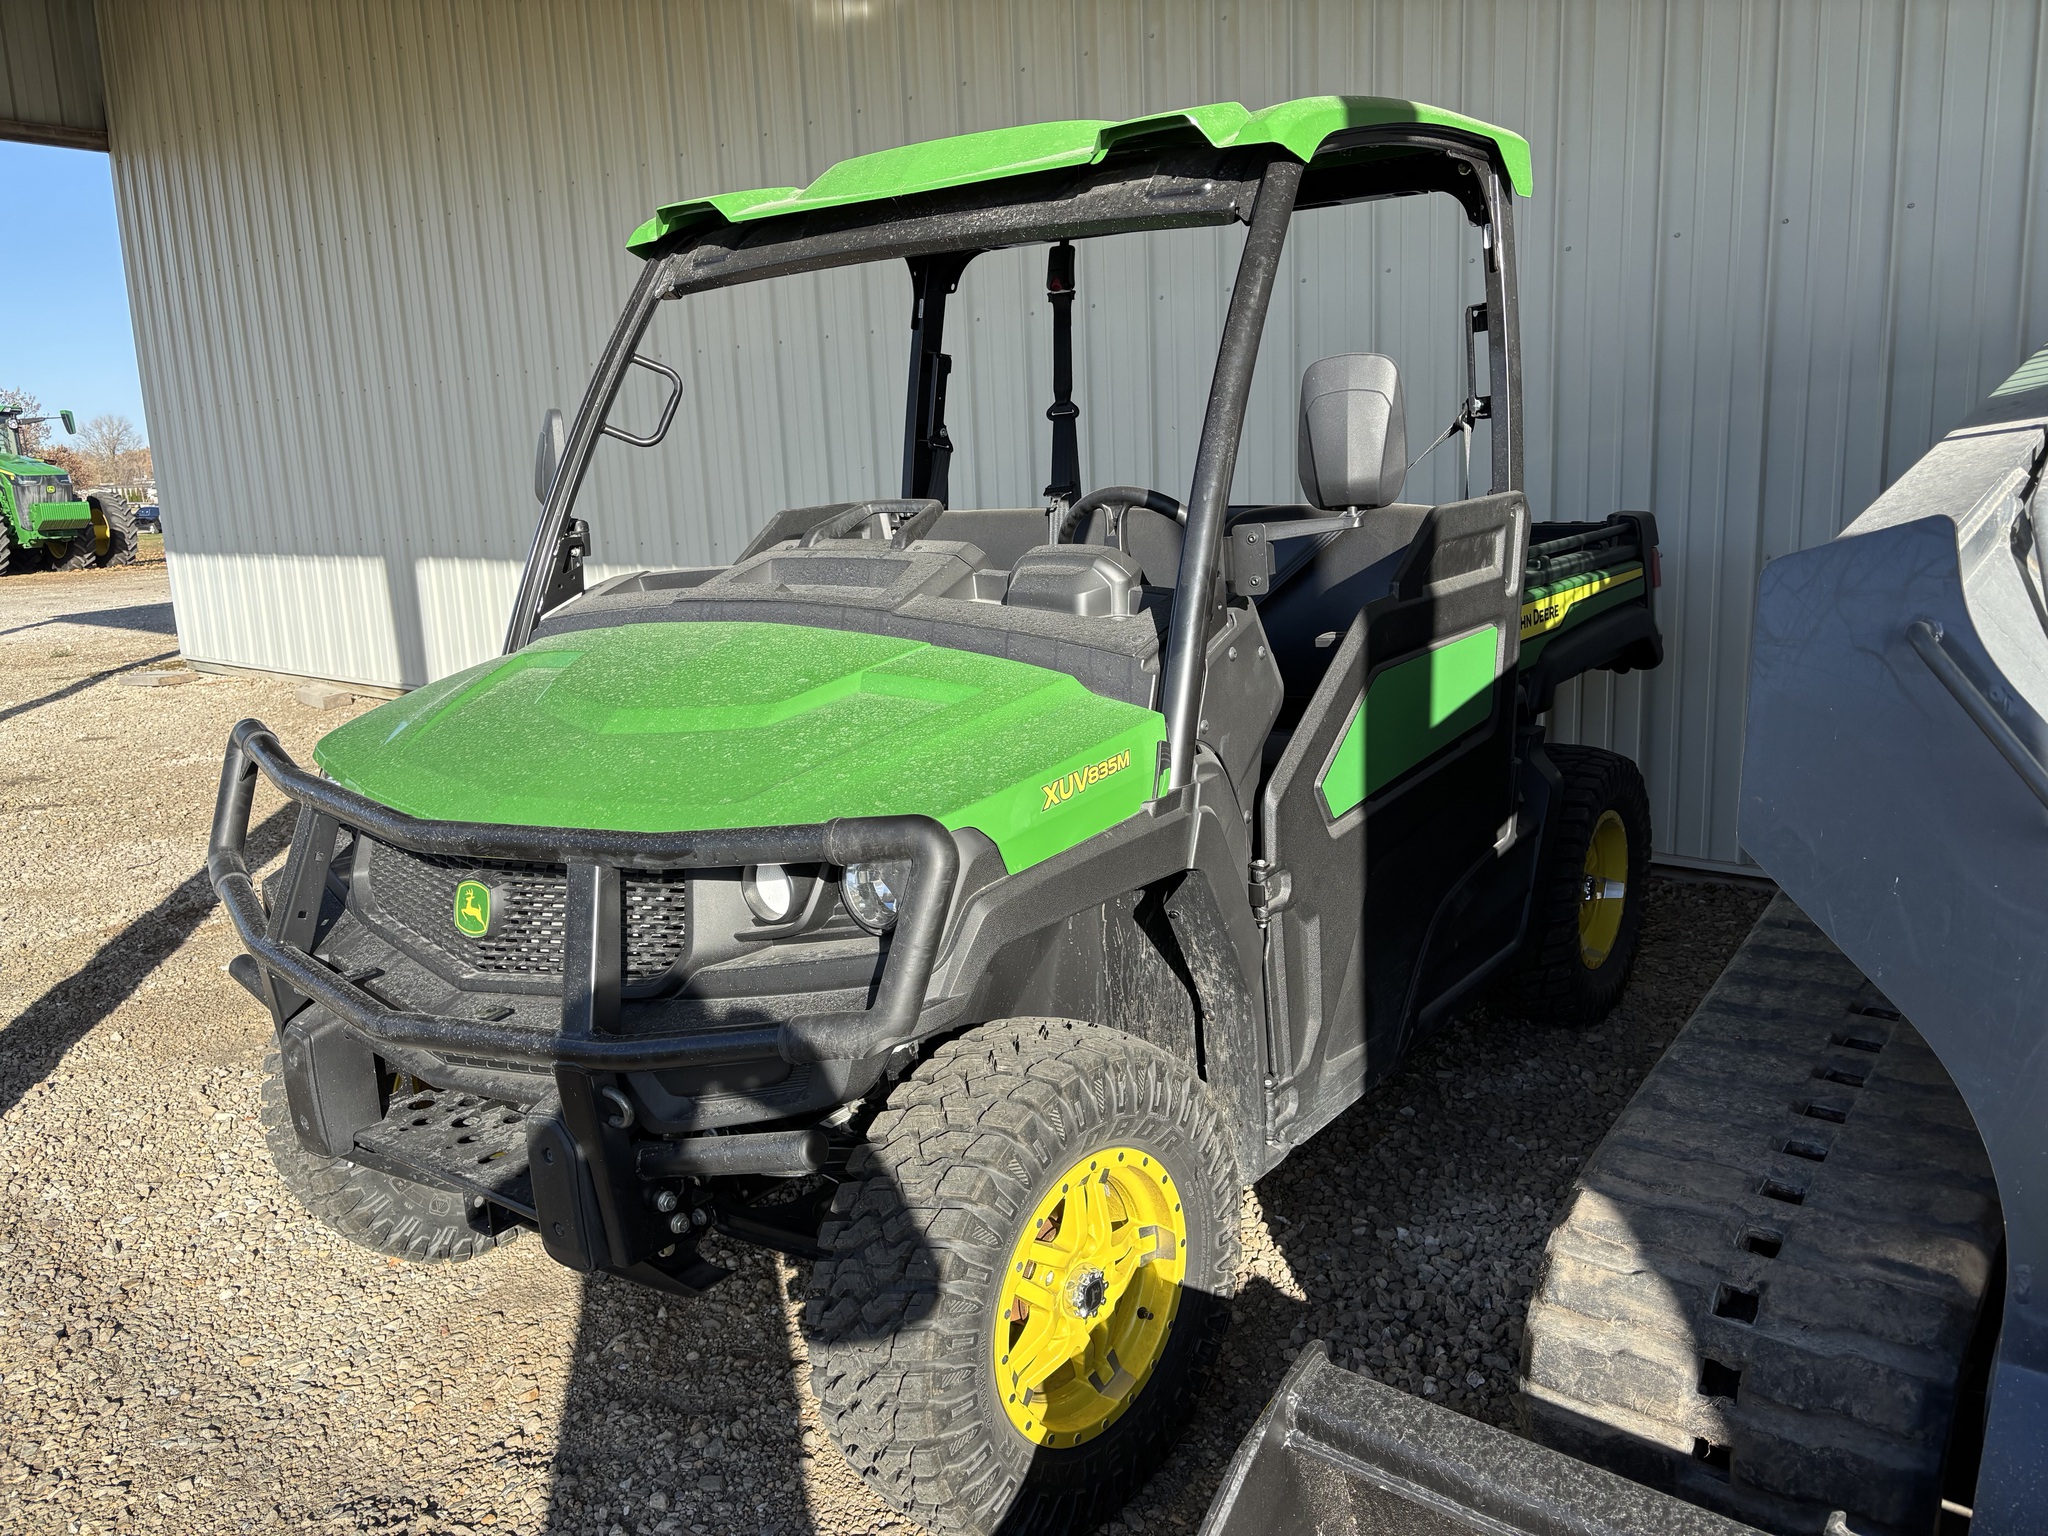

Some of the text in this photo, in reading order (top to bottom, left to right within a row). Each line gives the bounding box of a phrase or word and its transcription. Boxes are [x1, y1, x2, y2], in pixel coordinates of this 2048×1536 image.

[1520, 605, 1559, 630] HN DEERE
[1041, 749, 1131, 812] XUV835M
